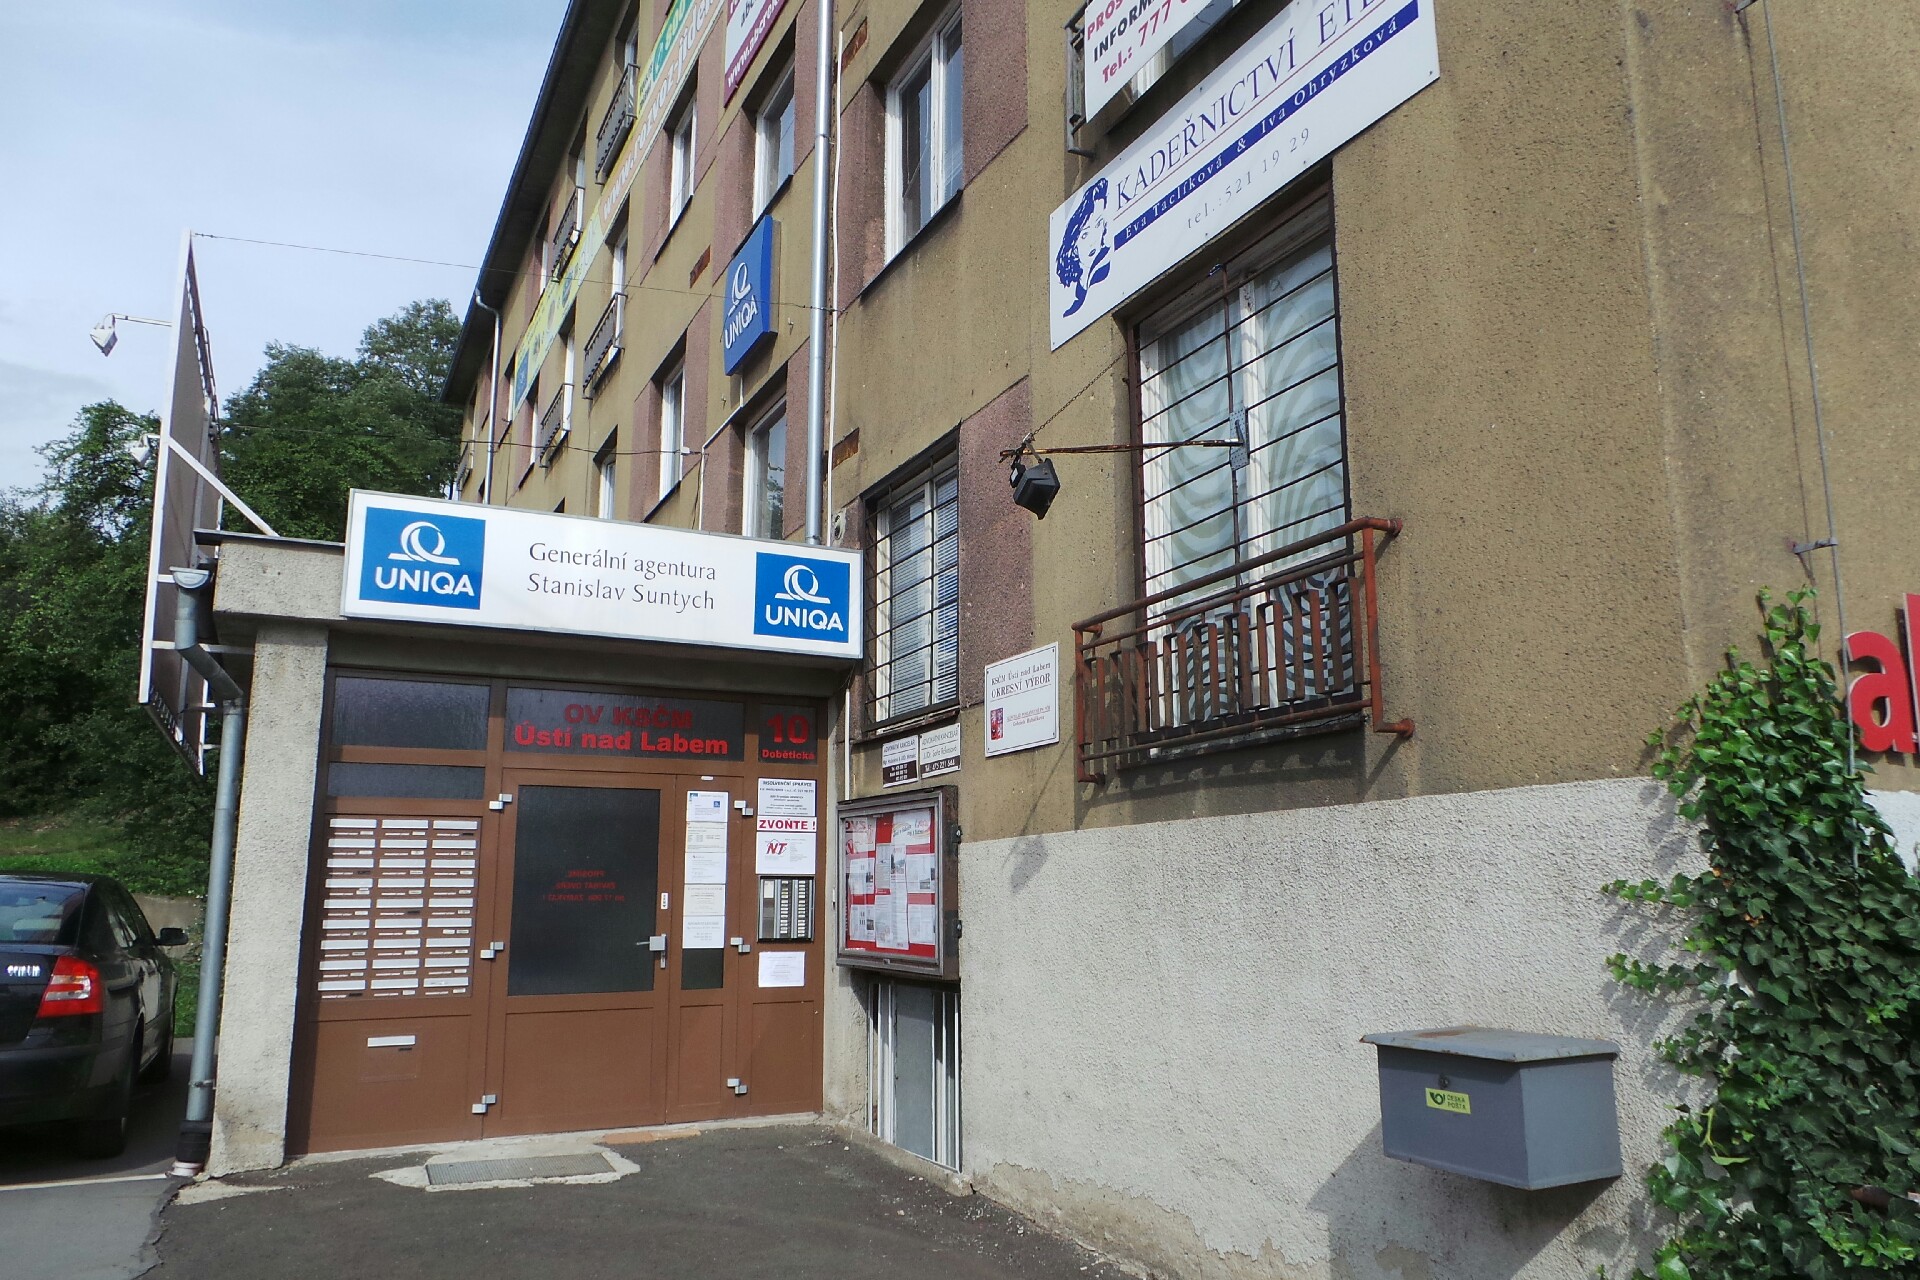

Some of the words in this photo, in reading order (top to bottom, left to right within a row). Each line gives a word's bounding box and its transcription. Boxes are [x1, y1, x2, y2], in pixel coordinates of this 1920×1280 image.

[1102, 47, 1132, 83] Tel.:
[1138, 0, 1172, 47] 777
[1115, 27, 1298, 211] KADEŘNICTVÍ
[1126, 217, 1147, 239] Eva
[1237, 137, 1246, 153] &
[1262, 108, 1285, 134] Iva
[1294, 16, 1398, 106] Ohryzková
[1263, 150, 1280, 173] 19
[1289, 128, 1309, 153] 29
[724, 295, 758, 349] UNIQA
[529, 542, 628, 571] Generální
[634, 558, 716, 581] agentura
[375, 566, 475, 597] UNIQA
[527, 573, 626, 601] Stanislav
[632, 584, 715, 614] Suntych
[766, 604, 844, 632] UNIQA
[991, 679, 1023, 698] OKRESNÍ
[1025, 672, 1051, 690] VÝBOR
[564, 703, 604, 724] OV
[611, 705, 693, 730] KSČM
[767, 714, 810, 744] 10
[514, 720, 572, 748] Ústí
[582, 731, 631, 750] nad
[641, 732, 729, 755] Labem
[759, 817, 808, 830] ZVOŇTE
